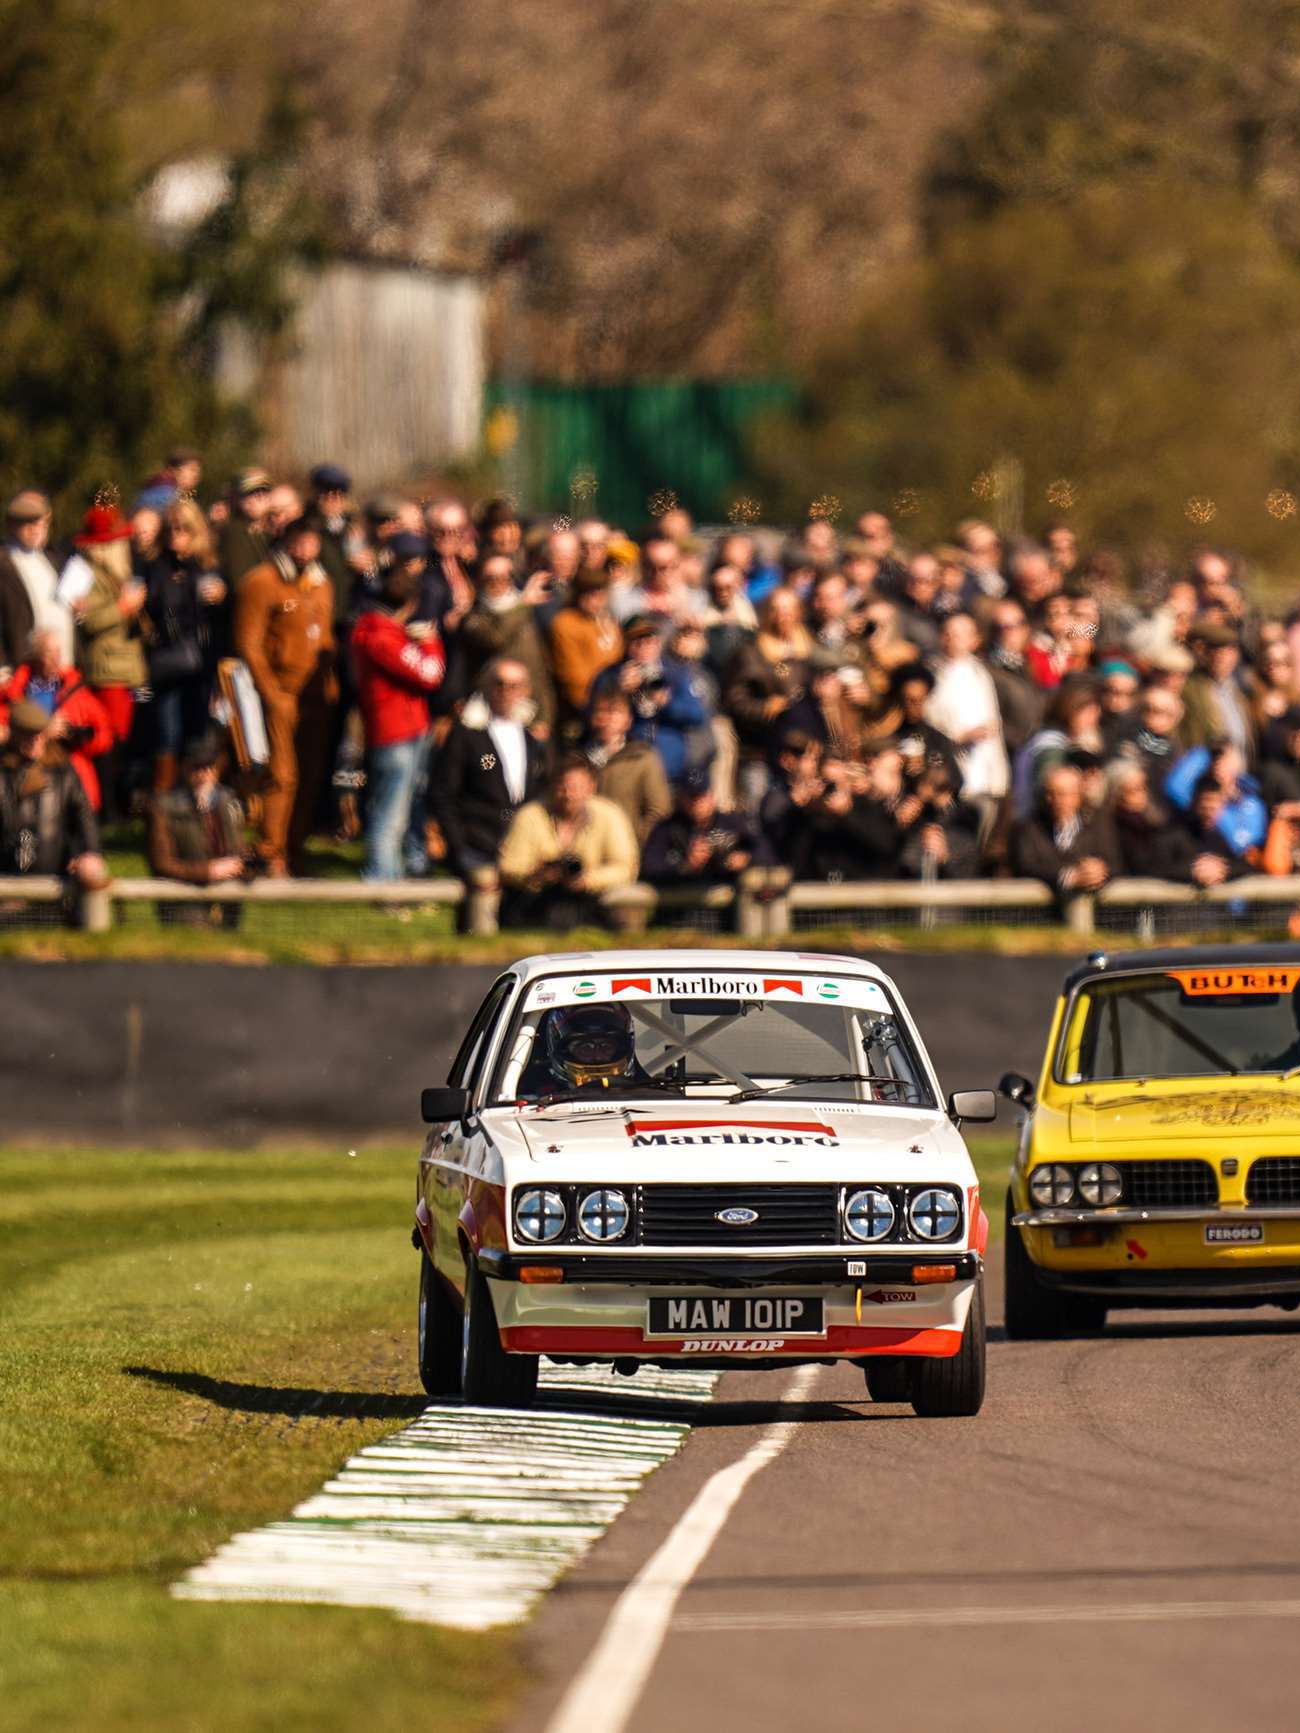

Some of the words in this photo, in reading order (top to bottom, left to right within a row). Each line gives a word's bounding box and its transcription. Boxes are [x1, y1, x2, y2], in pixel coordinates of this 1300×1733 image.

[656, 977, 758, 995] Marlboro
[631, 1133, 840, 1148] Marlboro
[1208, 1228, 1260, 1240] FERODO
[883, 1293, 914, 1302] TOW
[668, 1300, 730, 1329] MAW
[745, 1300, 804, 1329] 101P
[681, 1340, 784, 1352] DUNLOP
